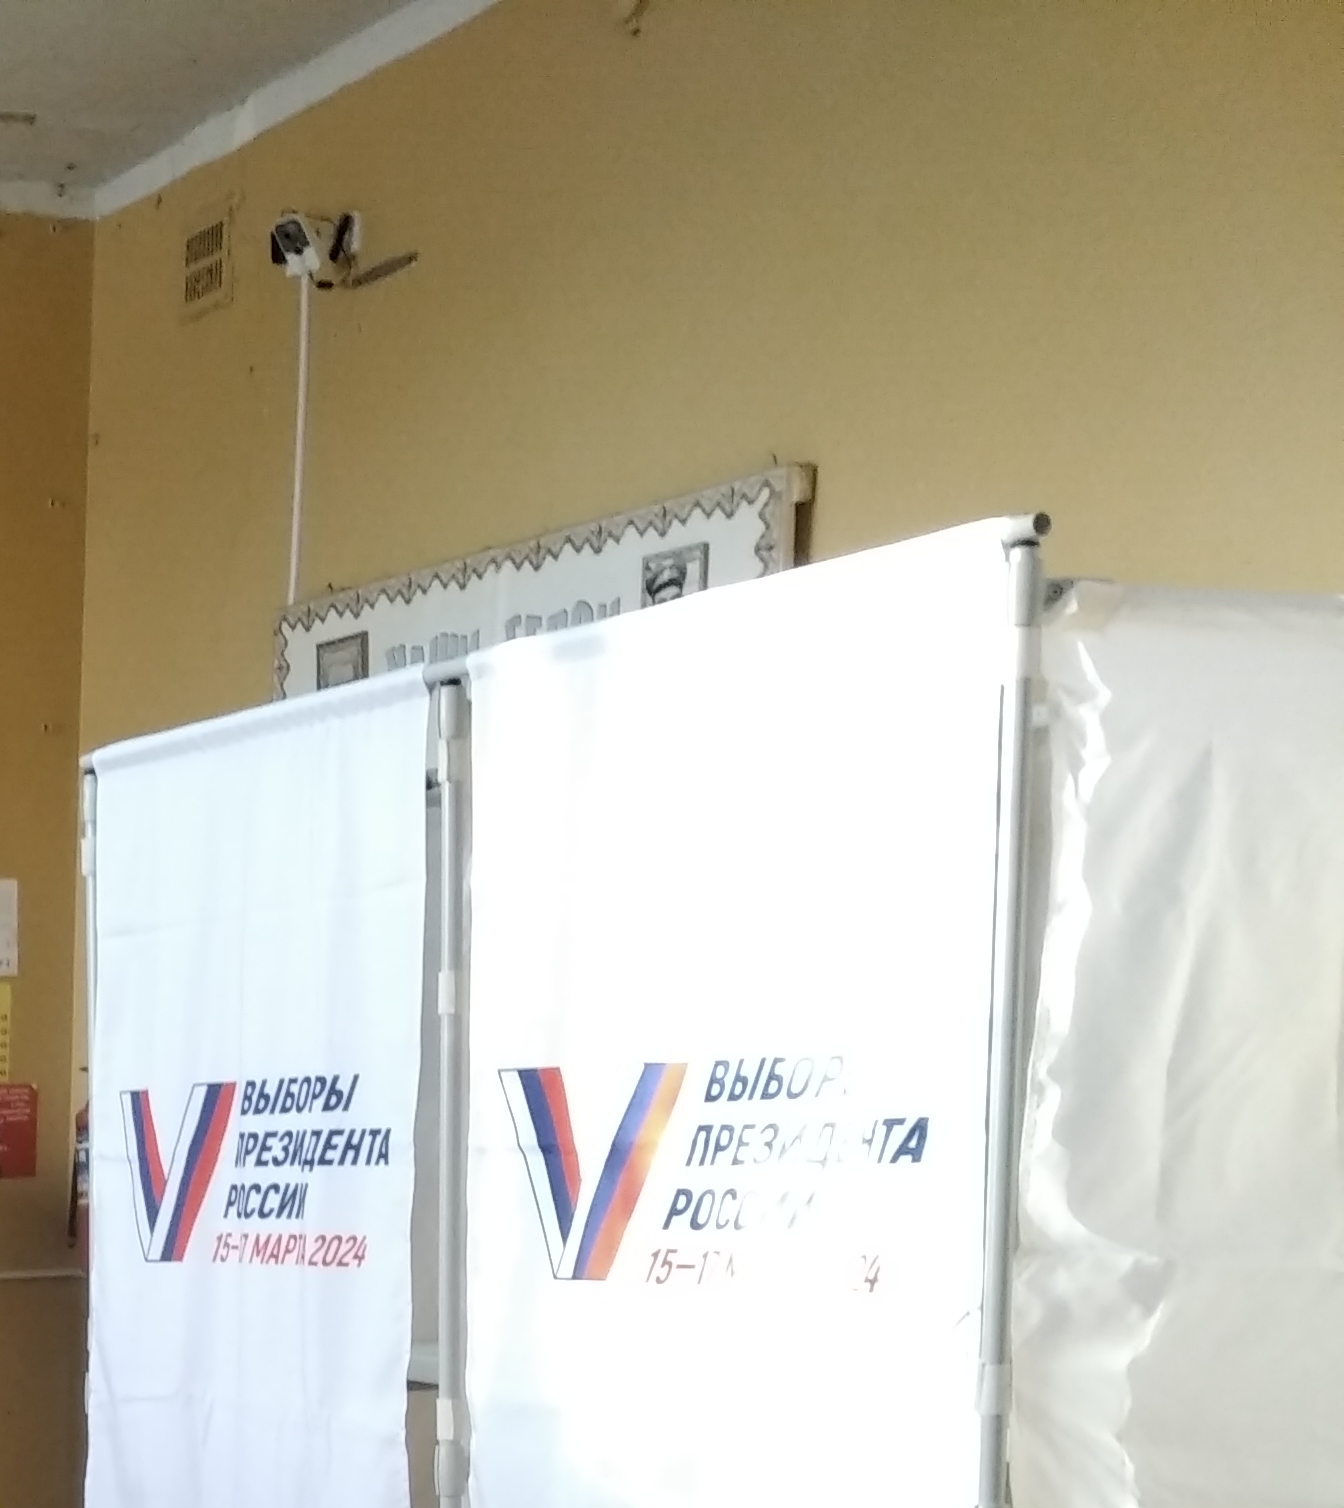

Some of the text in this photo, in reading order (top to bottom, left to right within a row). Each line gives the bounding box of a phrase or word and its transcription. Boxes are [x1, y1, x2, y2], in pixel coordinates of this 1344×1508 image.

[239, 1073, 360, 1116] ВЫБОРЫ
[703, 1056, 852, 1103] ВЫБОР
[234, 1127, 391, 1172] ПРЕЗИДЕНТА
[223, 1183, 308, 1220] РОССИИ
[307, 1234, 368, 1268] 2024
